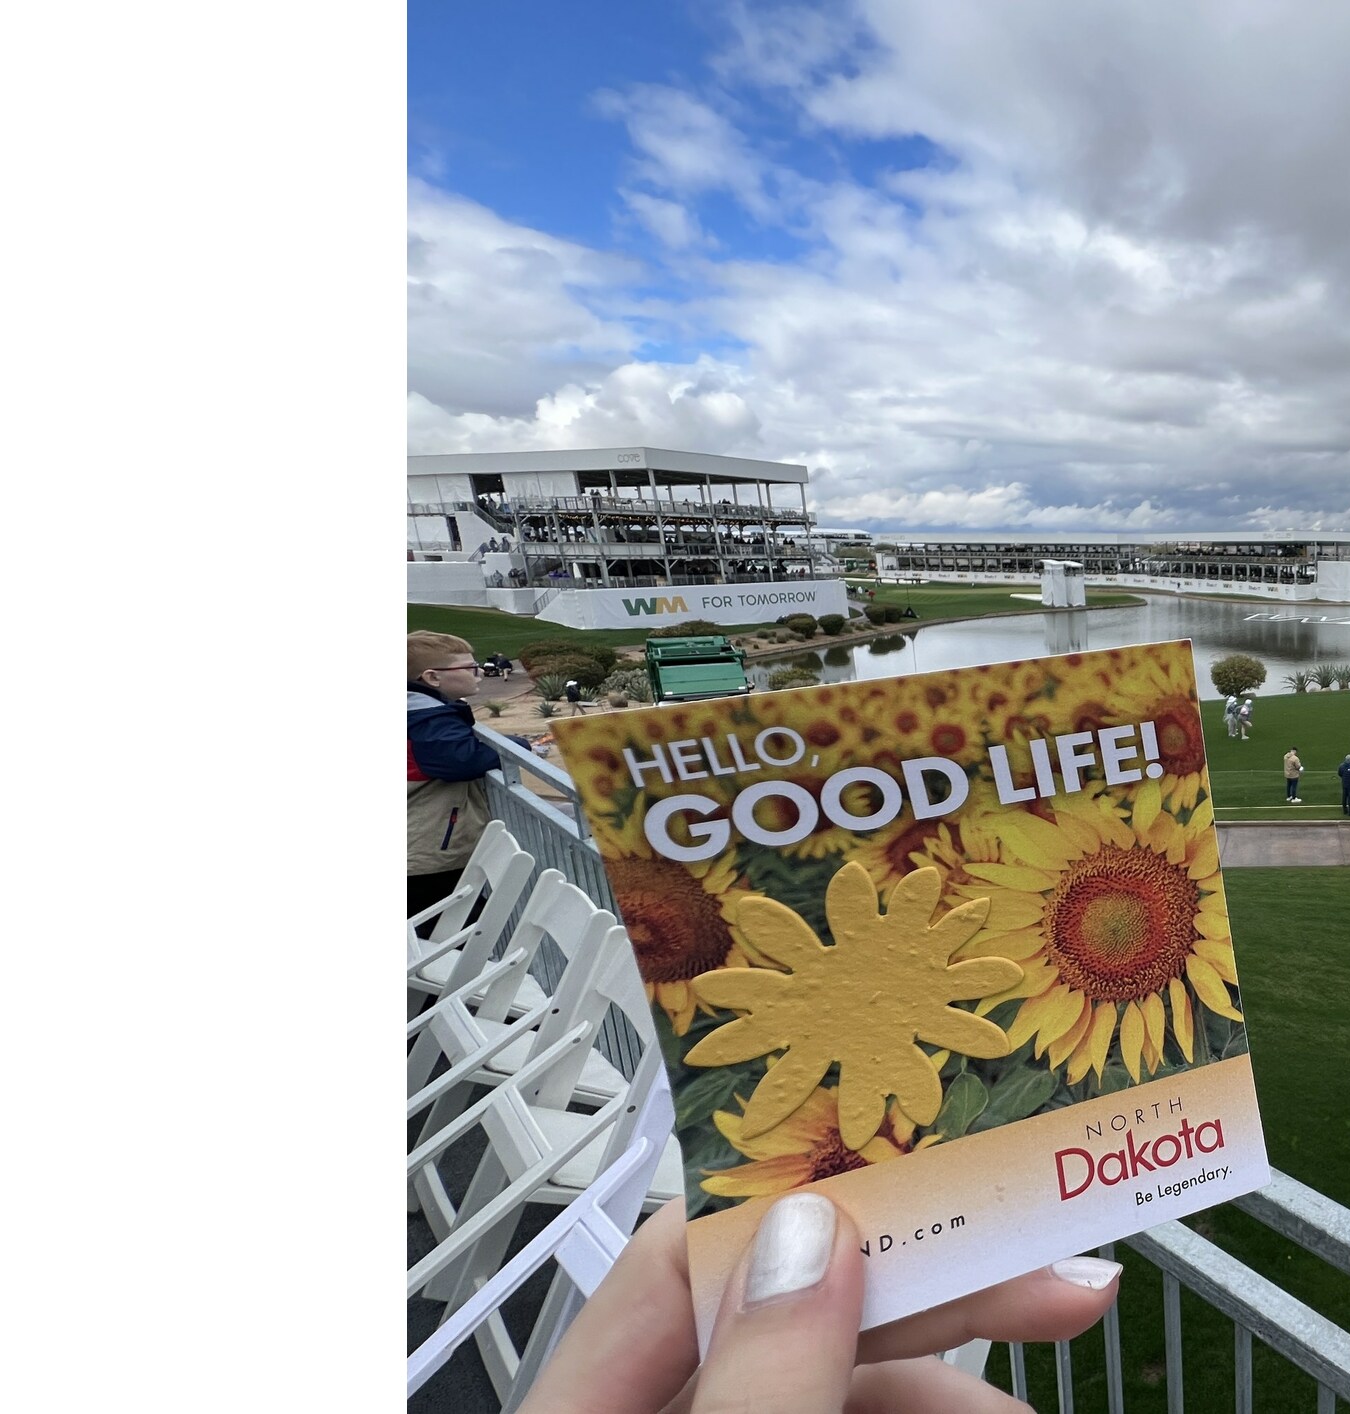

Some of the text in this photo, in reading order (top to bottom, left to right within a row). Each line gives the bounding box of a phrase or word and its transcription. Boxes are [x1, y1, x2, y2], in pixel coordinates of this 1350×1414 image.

[621, 596, 689, 616] WM
[702, 591, 817, 609] FOR TOMORROW
[621, 726, 819, 788] HELLO,
[643, 720, 1164, 863] GOOD LIFE!
[1086, 1096, 1183, 1140] NORTH
[1054, 1117, 1225, 1202] Dakota
[1135, 1165, 1233, 1206] Be Legendary.
